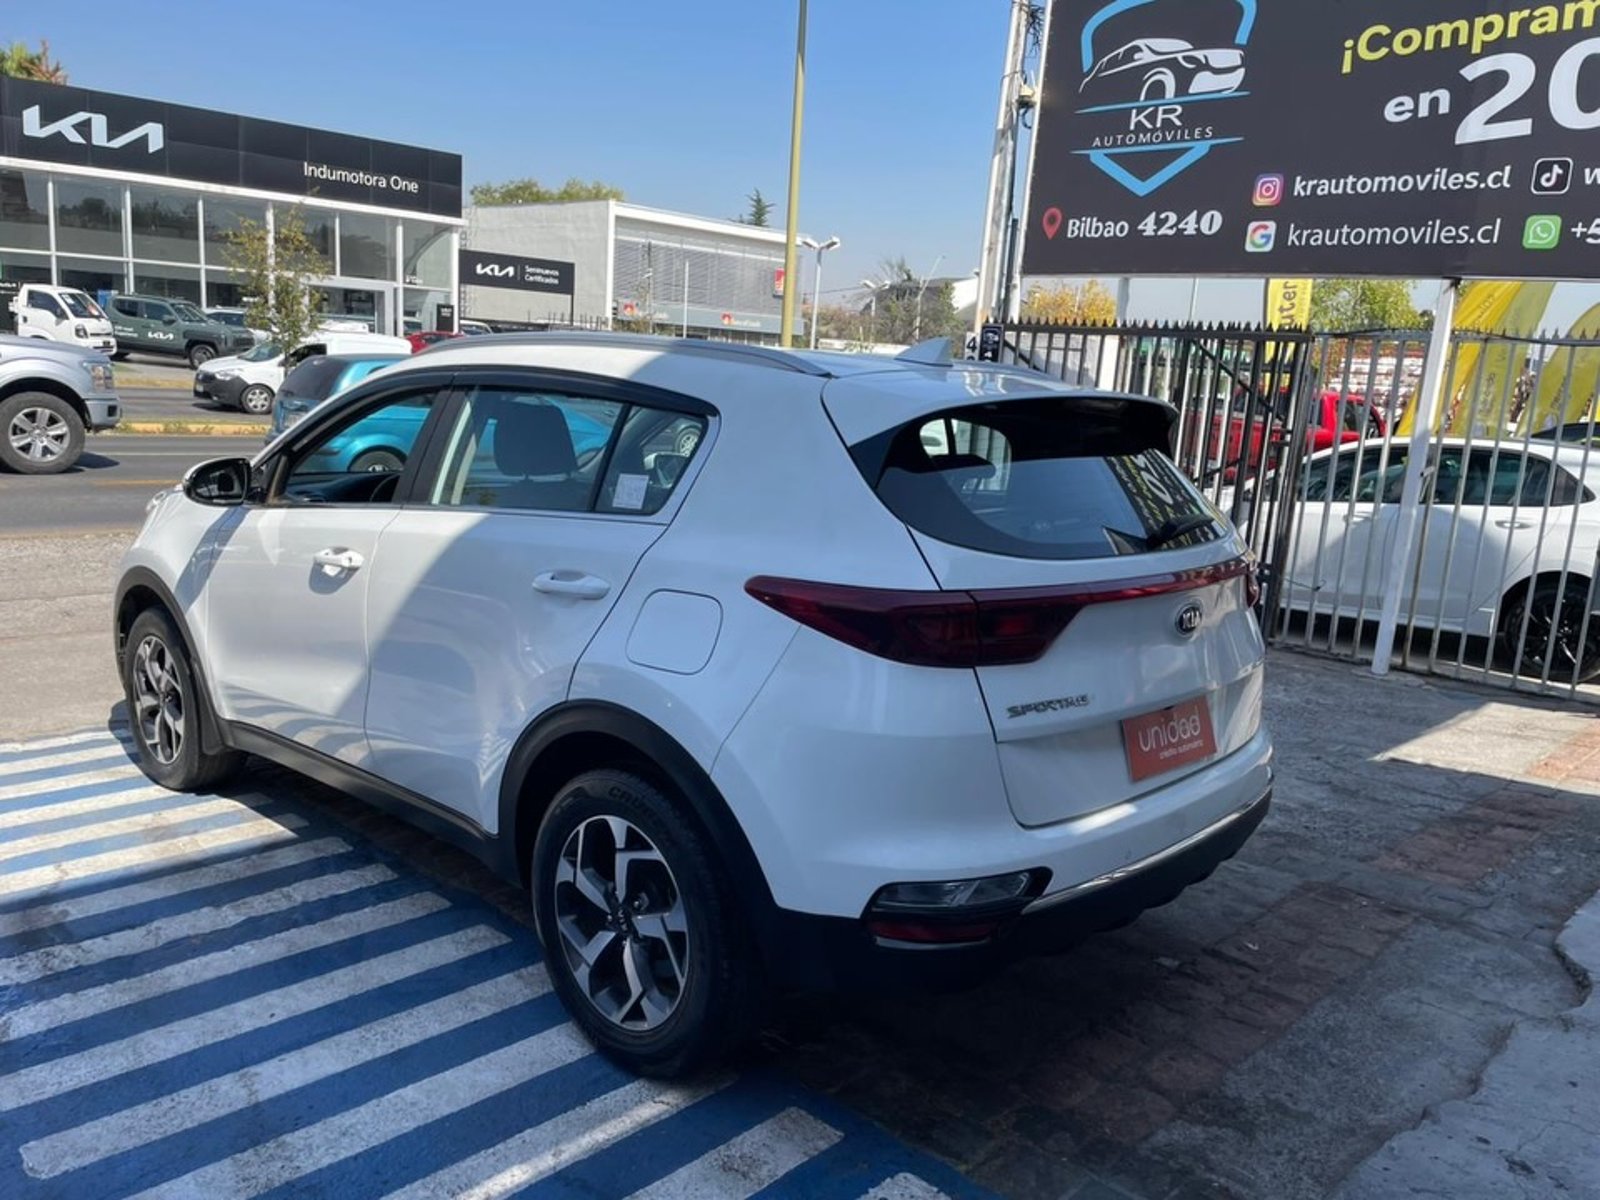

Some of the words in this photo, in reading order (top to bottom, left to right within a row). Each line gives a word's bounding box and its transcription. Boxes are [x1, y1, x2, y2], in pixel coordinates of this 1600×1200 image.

[1129, 104, 1182, 131] KR
[1384, 87, 1451, 123] en
[1092, 126, 1213, 147] AUTOMÓVILES
[303, 161, 387, 188] Indumotora
[390, 175, 419, 193] One
[1293, 164, 1512, 197] krautomoviles.cl
[1067, 217, 1129, 238] Bilbao
[1137, 209, 1223, 236] 4240
[1287, 217, 1501, 246] krautomoviles.cl
